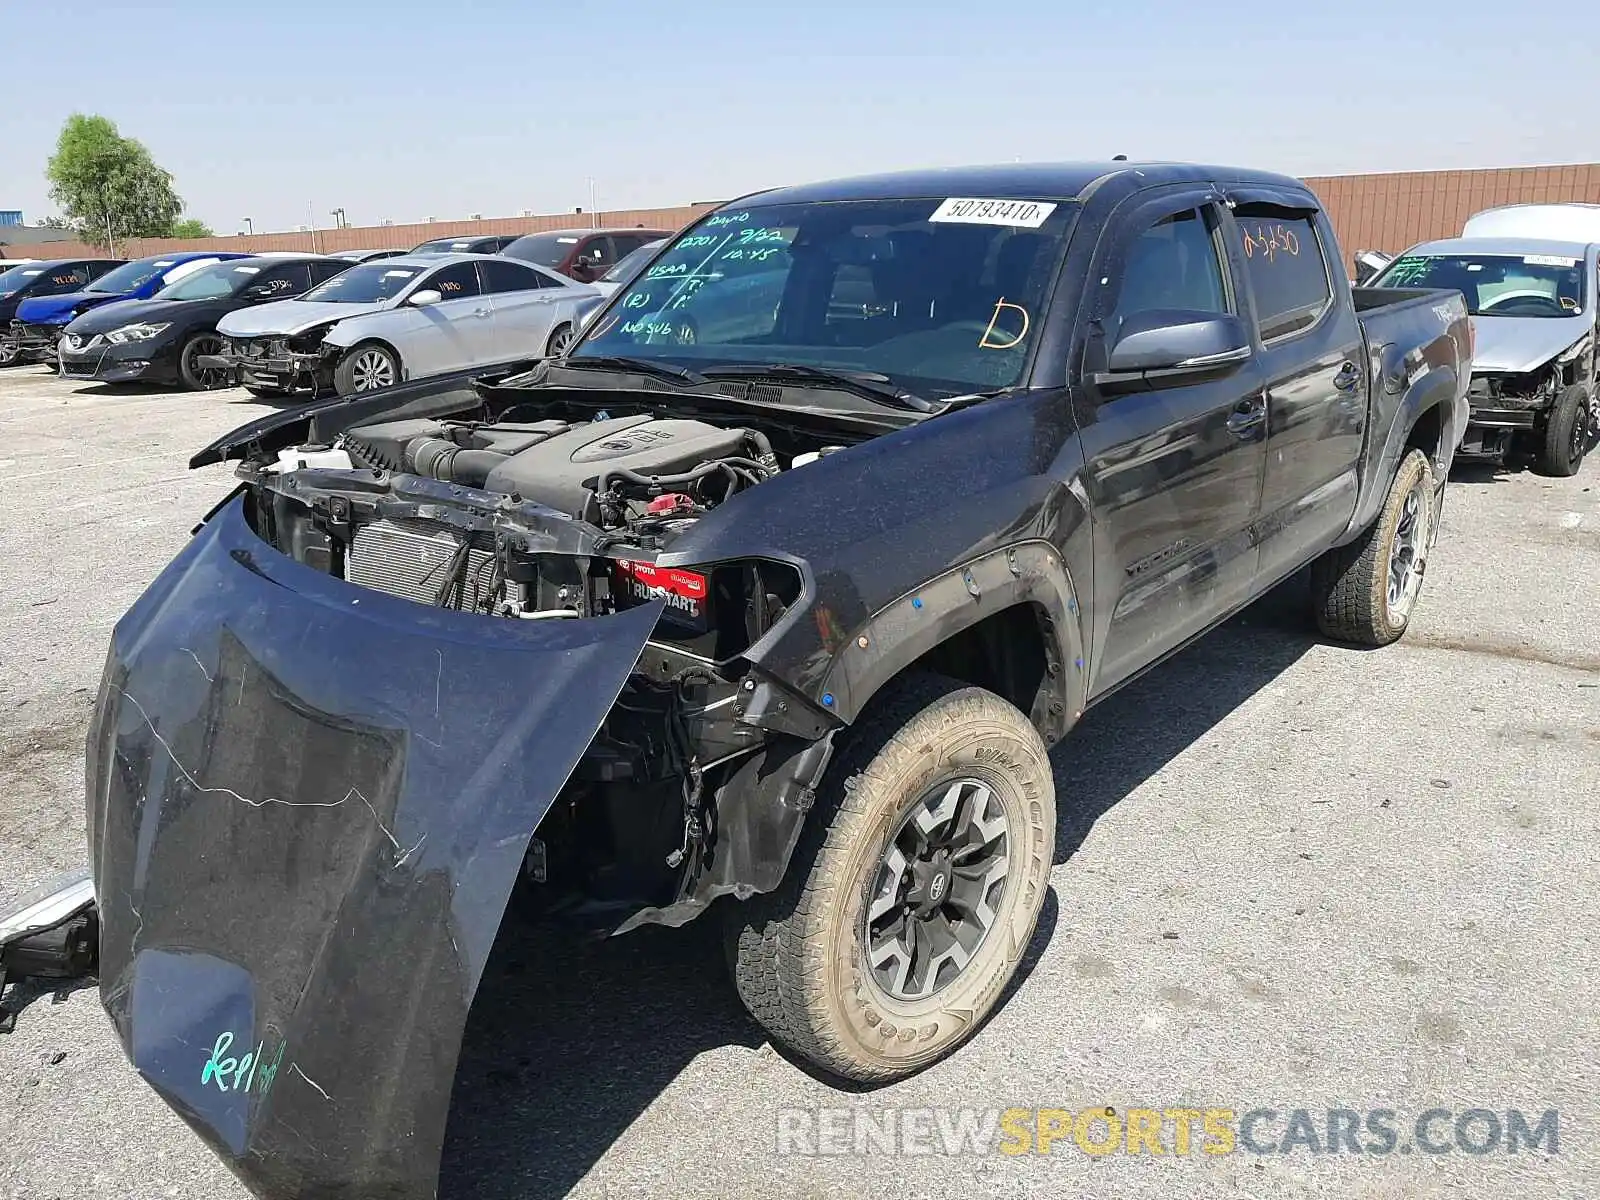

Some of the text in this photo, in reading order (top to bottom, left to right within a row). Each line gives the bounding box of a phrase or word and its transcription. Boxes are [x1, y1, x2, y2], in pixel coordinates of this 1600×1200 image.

[740, 228, 783, 244] 9/22
[648, 264, 687, 277] USAA
[979, 297, 1029, 349] D
